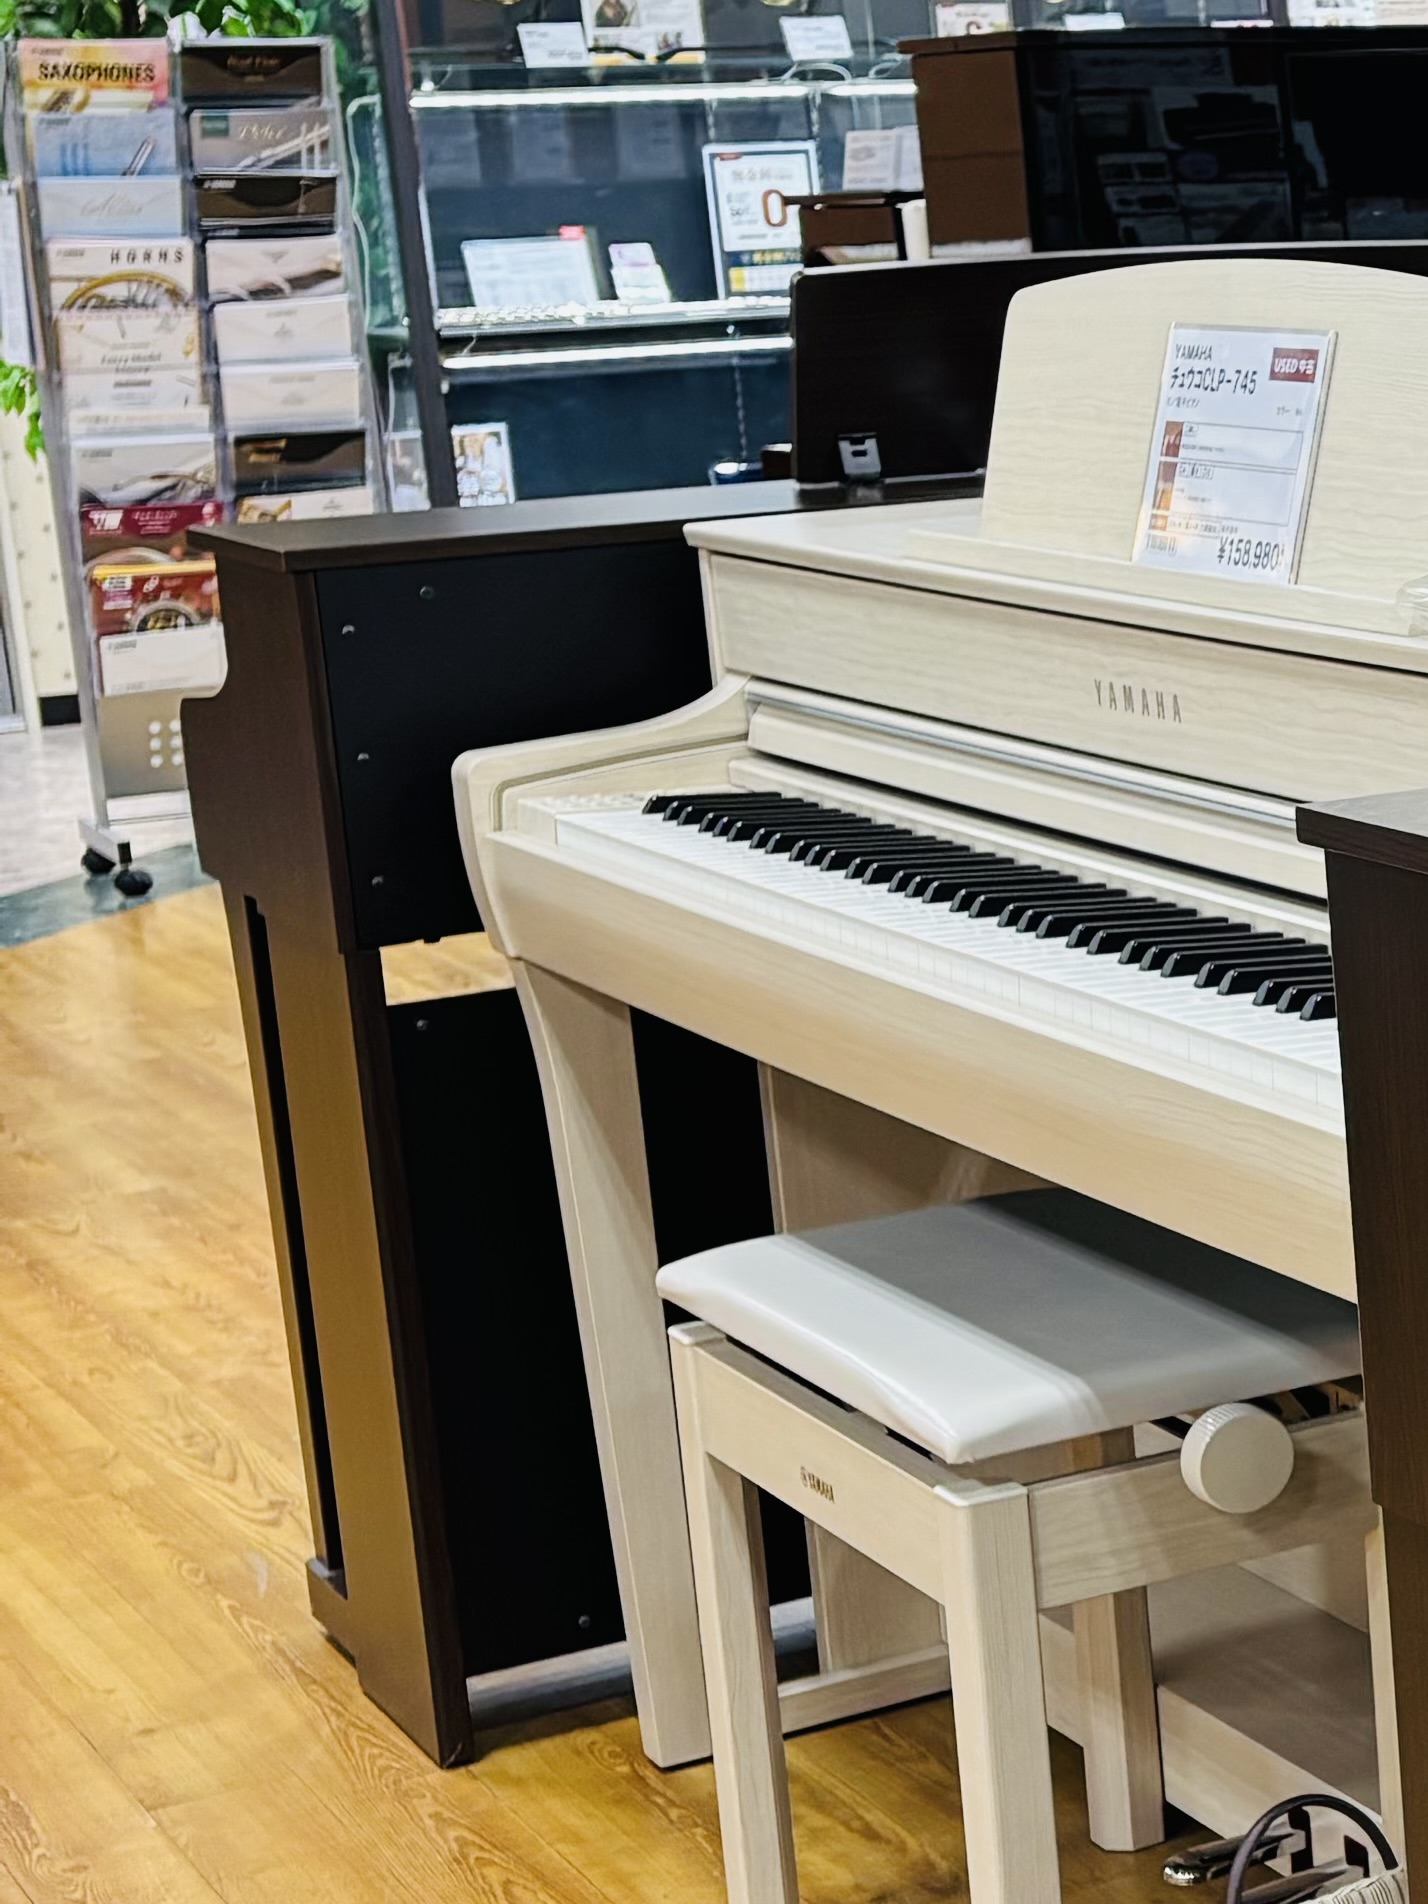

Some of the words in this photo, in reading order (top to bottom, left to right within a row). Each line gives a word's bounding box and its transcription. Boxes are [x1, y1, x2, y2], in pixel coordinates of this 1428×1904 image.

[38, 62, 156, 85] SAXOPHONES
[1174, 343, 1213, 361] YAMAHA
[1274, 357, 1298, 373] USED
[1093, 678, 1183, 725] YAMAHA
